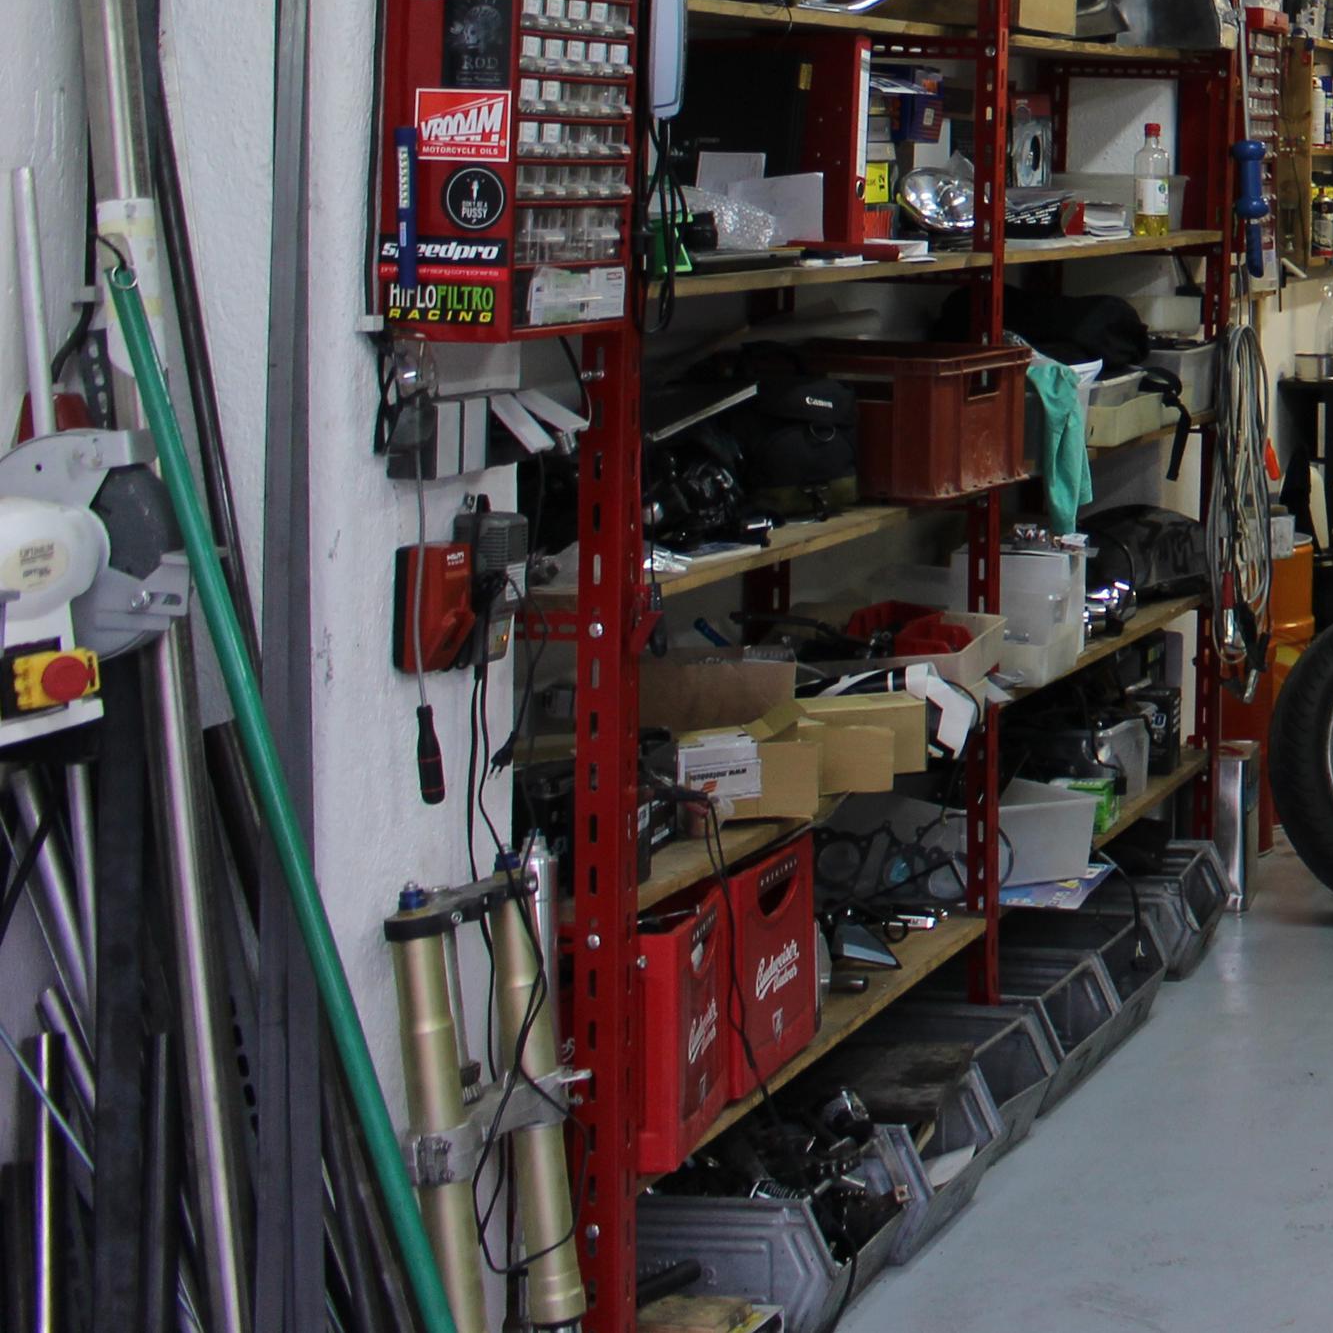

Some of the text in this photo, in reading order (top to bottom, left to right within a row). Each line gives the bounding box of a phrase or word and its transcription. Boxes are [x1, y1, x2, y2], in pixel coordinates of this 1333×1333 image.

[462, 54, 499, 70] ROD
[421, 100, 505, 146] VROOAM
[422, 146, 499, 155] MOTORCYCLE OILS
[461, 207, 489, 219] PUSSY
[381, 241, 500, 261] seedpro
[388, 309, 493, 323] RACING
[805, 395, 833, 409] Canon
